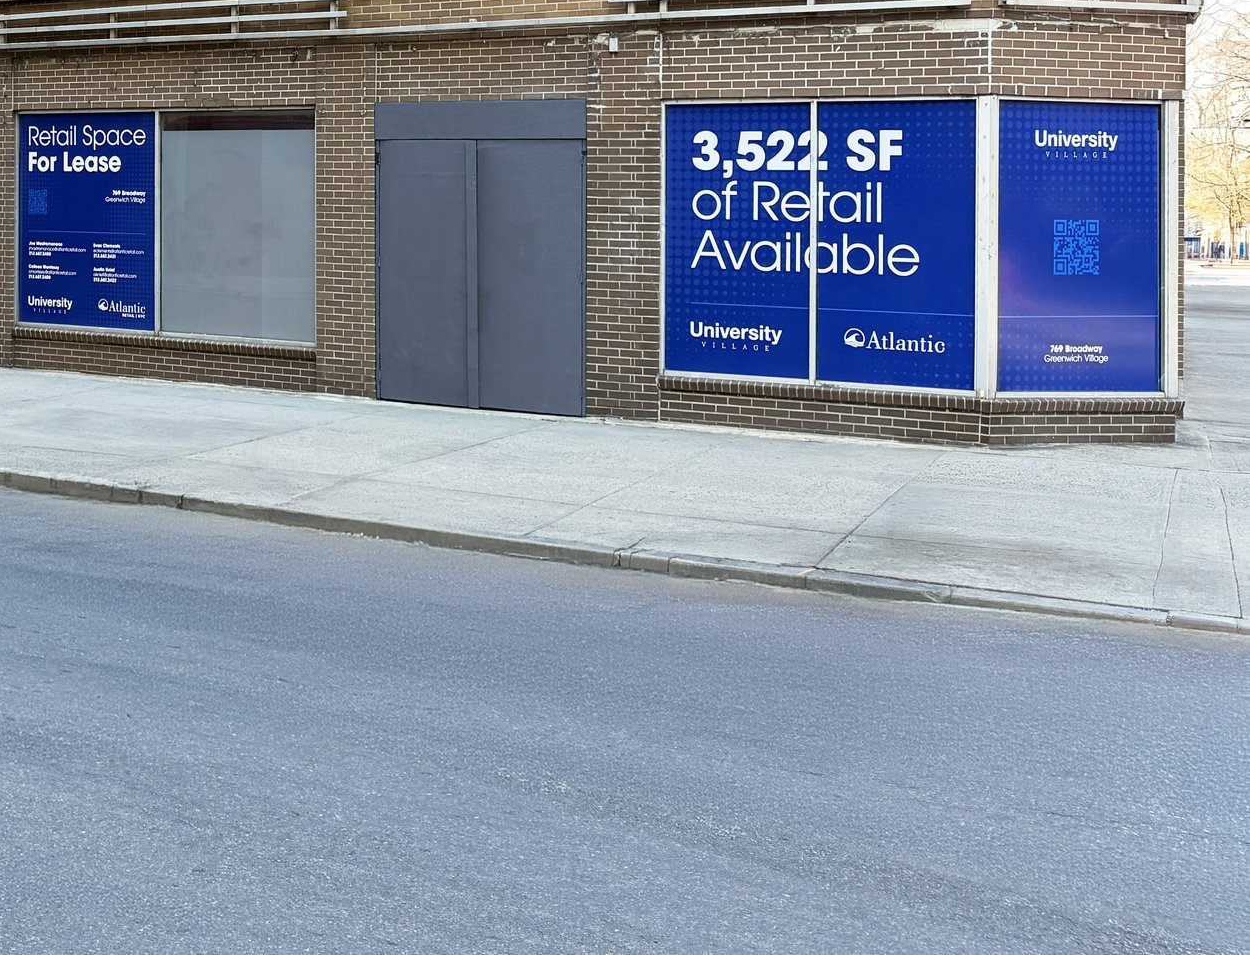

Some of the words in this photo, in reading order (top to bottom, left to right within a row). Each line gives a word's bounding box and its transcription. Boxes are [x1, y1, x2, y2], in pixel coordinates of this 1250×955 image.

[29, 125, 77, 146] Retail
[83, 125, 146, 150] Space
[1035, 130, 1119, 151] University
[28, 151, 57, 172] For
[63, 151, 122, 172] Lease
[692, 130, 828, 178] 3,522
[846, 129, 903, 171] SF
[131, 196, 146, 204] Village
[692, 180, 738, 220] of
[753, 181, 882, 223] Retail
[691, 230, 920, 277] Available
[28, 296, 73, 310] University
[109, 300, 146, 314] Atlantic
[690, 321, 782, 345] University
[866, 331, 946, 354] Atlantic
[701, 342, 770, 352] VILLAGE
[1065, 345, 1102, 354] Broadway
[1044, 354, 1082, 362] Greenwich
[1084, 354, 1108, 364] Village
